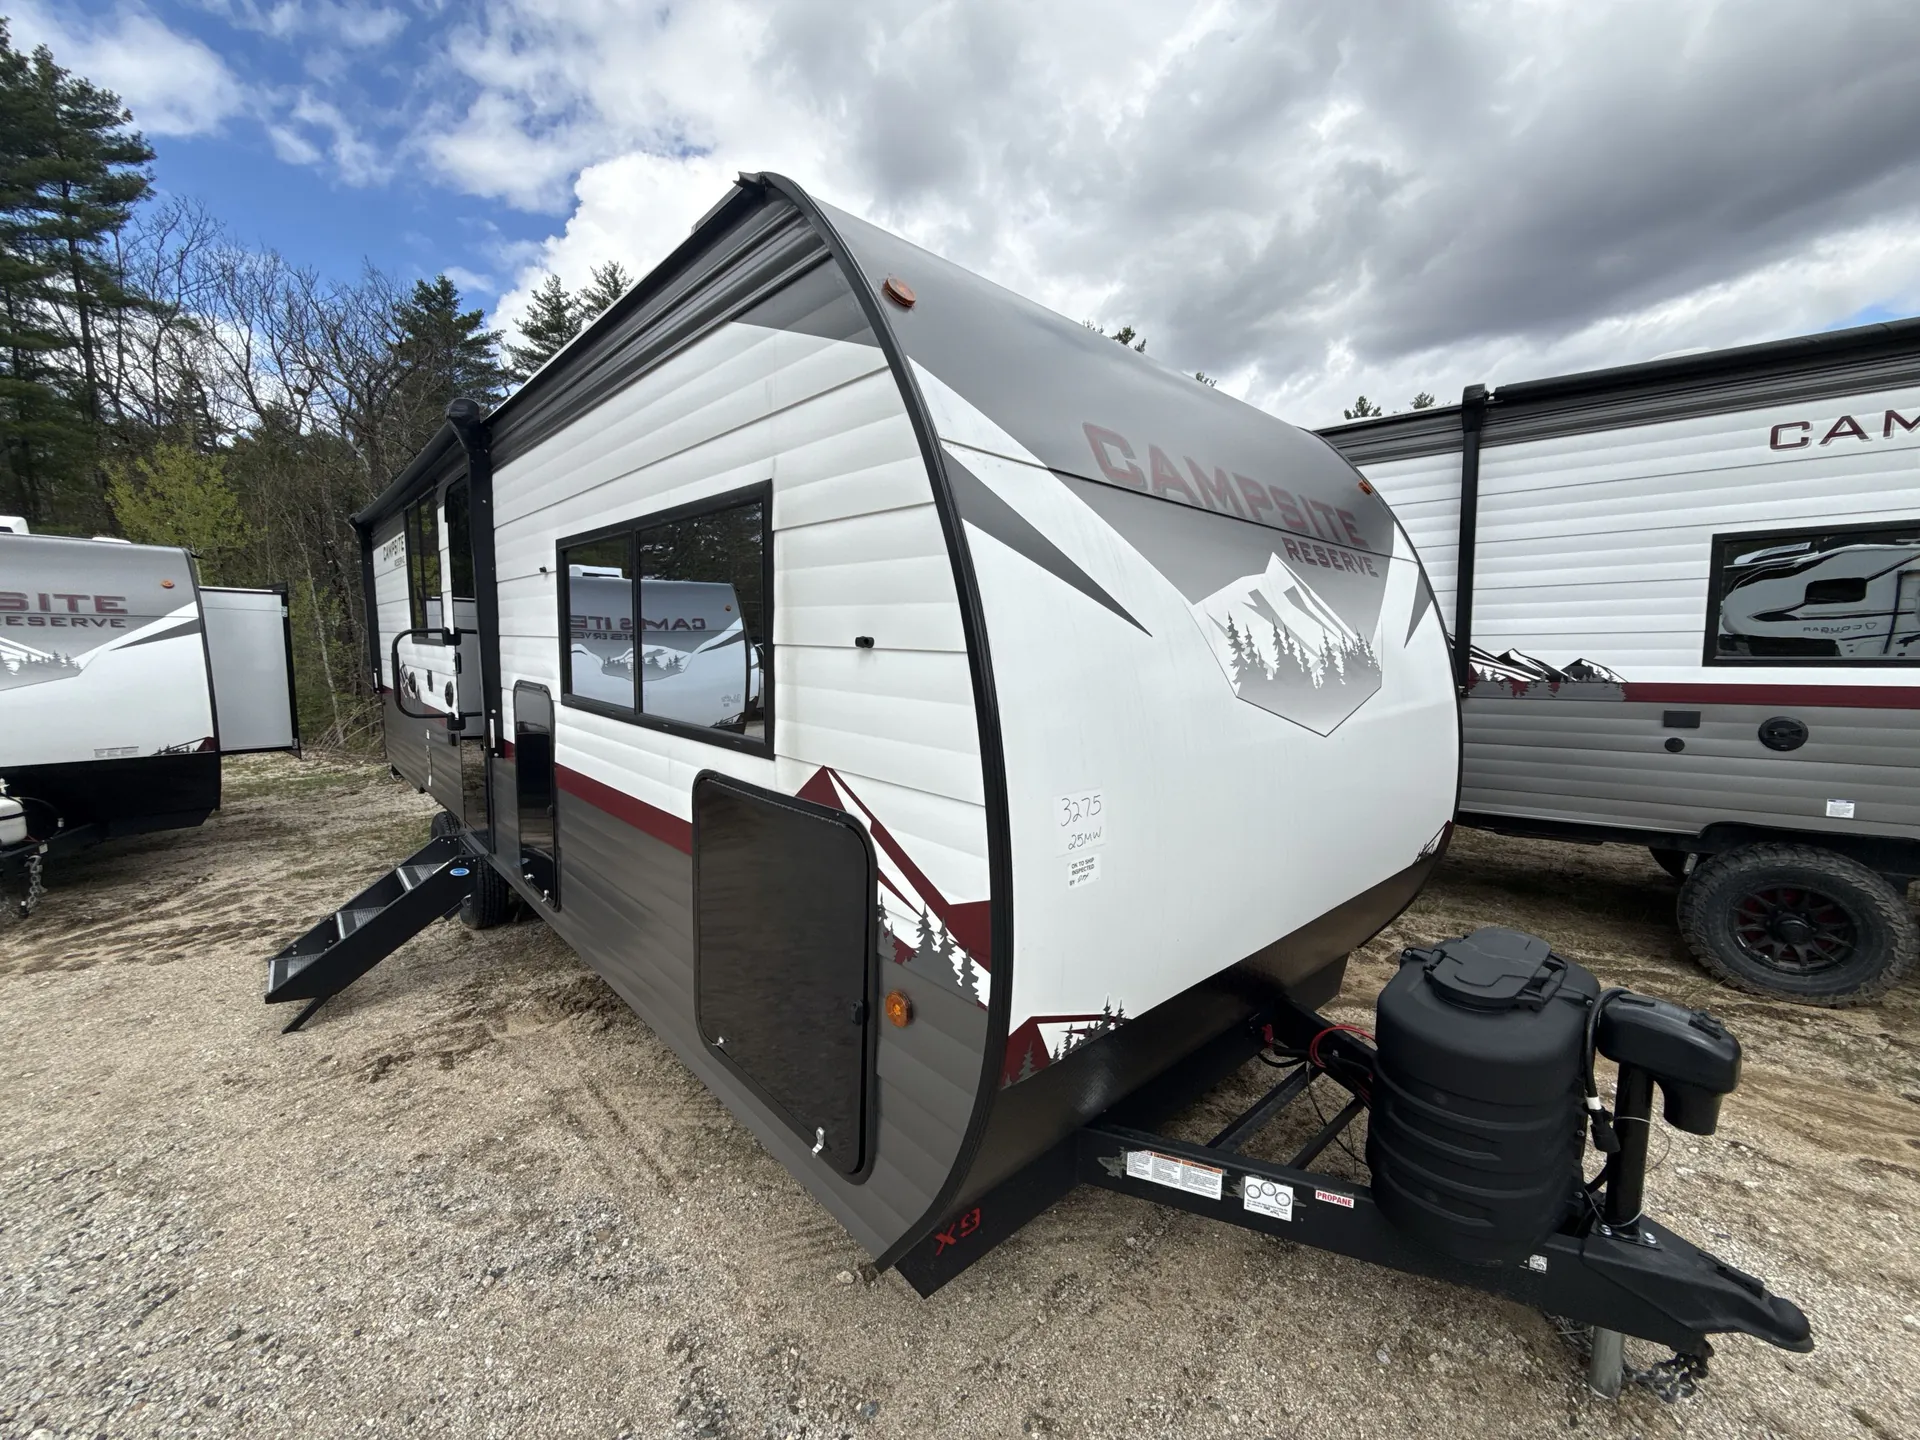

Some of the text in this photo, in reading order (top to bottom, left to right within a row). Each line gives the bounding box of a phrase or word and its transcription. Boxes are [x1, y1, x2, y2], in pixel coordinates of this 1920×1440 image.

[1082, 421, 1371, 549] CAMPSITE
[383, 534, 404, 561] CAMPSITE
[1281, 537, 1380, 578] RESERVE
[0, 616, 126, 628] ESERVE
[1061, 794, 1101, 827] 3275
[1068, 826, 1102, 850] 25MW
[1072, 864, 1094, 875] INSPECTED
[1316, 1191, 1353, 1207] PROPANE
